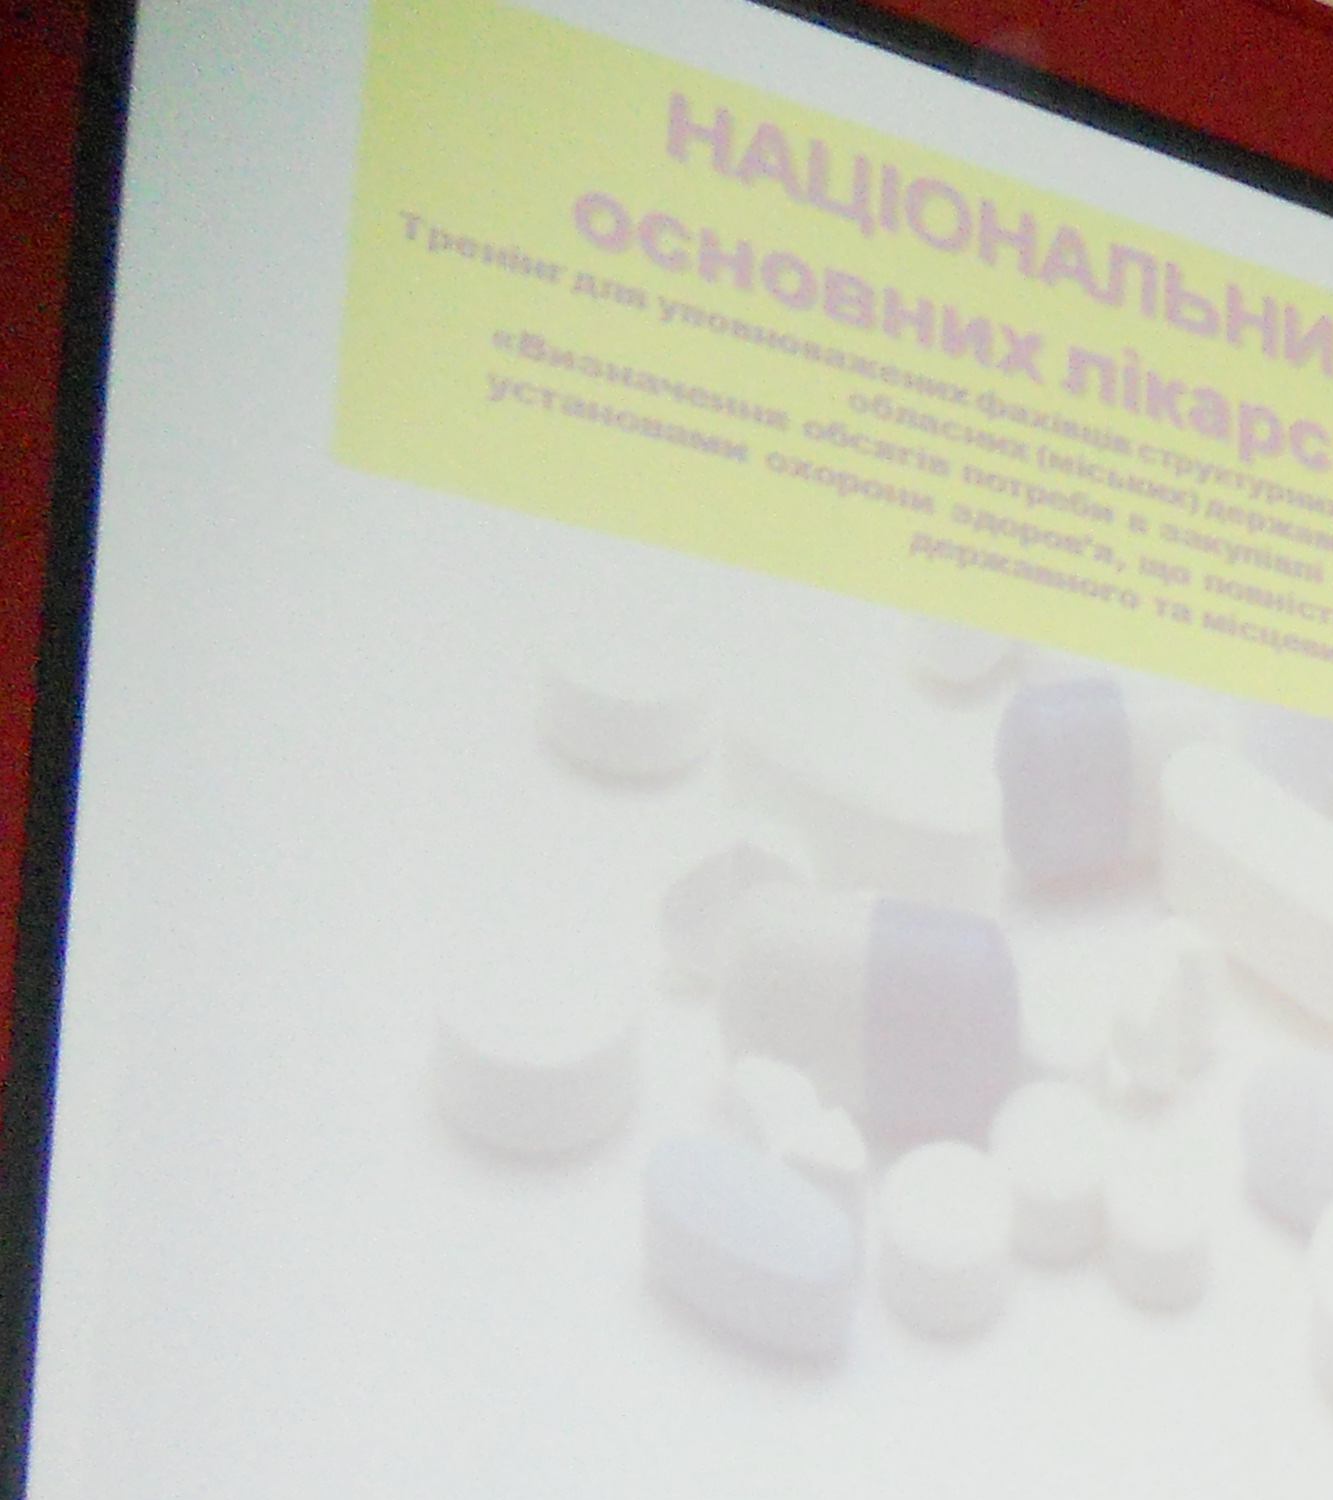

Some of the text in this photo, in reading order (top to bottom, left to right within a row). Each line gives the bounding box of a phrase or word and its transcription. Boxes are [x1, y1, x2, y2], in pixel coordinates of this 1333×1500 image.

[571, 272, 649, 311] для
[657, 295, 969, 403] уповноважених
[485, 371, 748, 462] установами
[764, 451, 935, 515] охорони
[1137, 555, 1192, 588] що
[848, 391, 1030, 463] обласних
[802, 418, 950, 477] обсягів
[963, 463, 1114, 523] потреби
[1129, 512, 1149, 535] в
[1159, 522, 1324, 584] закупівлі
[909, 532, 1141, 610] державного
[1152, 594, 1192, 626] та
